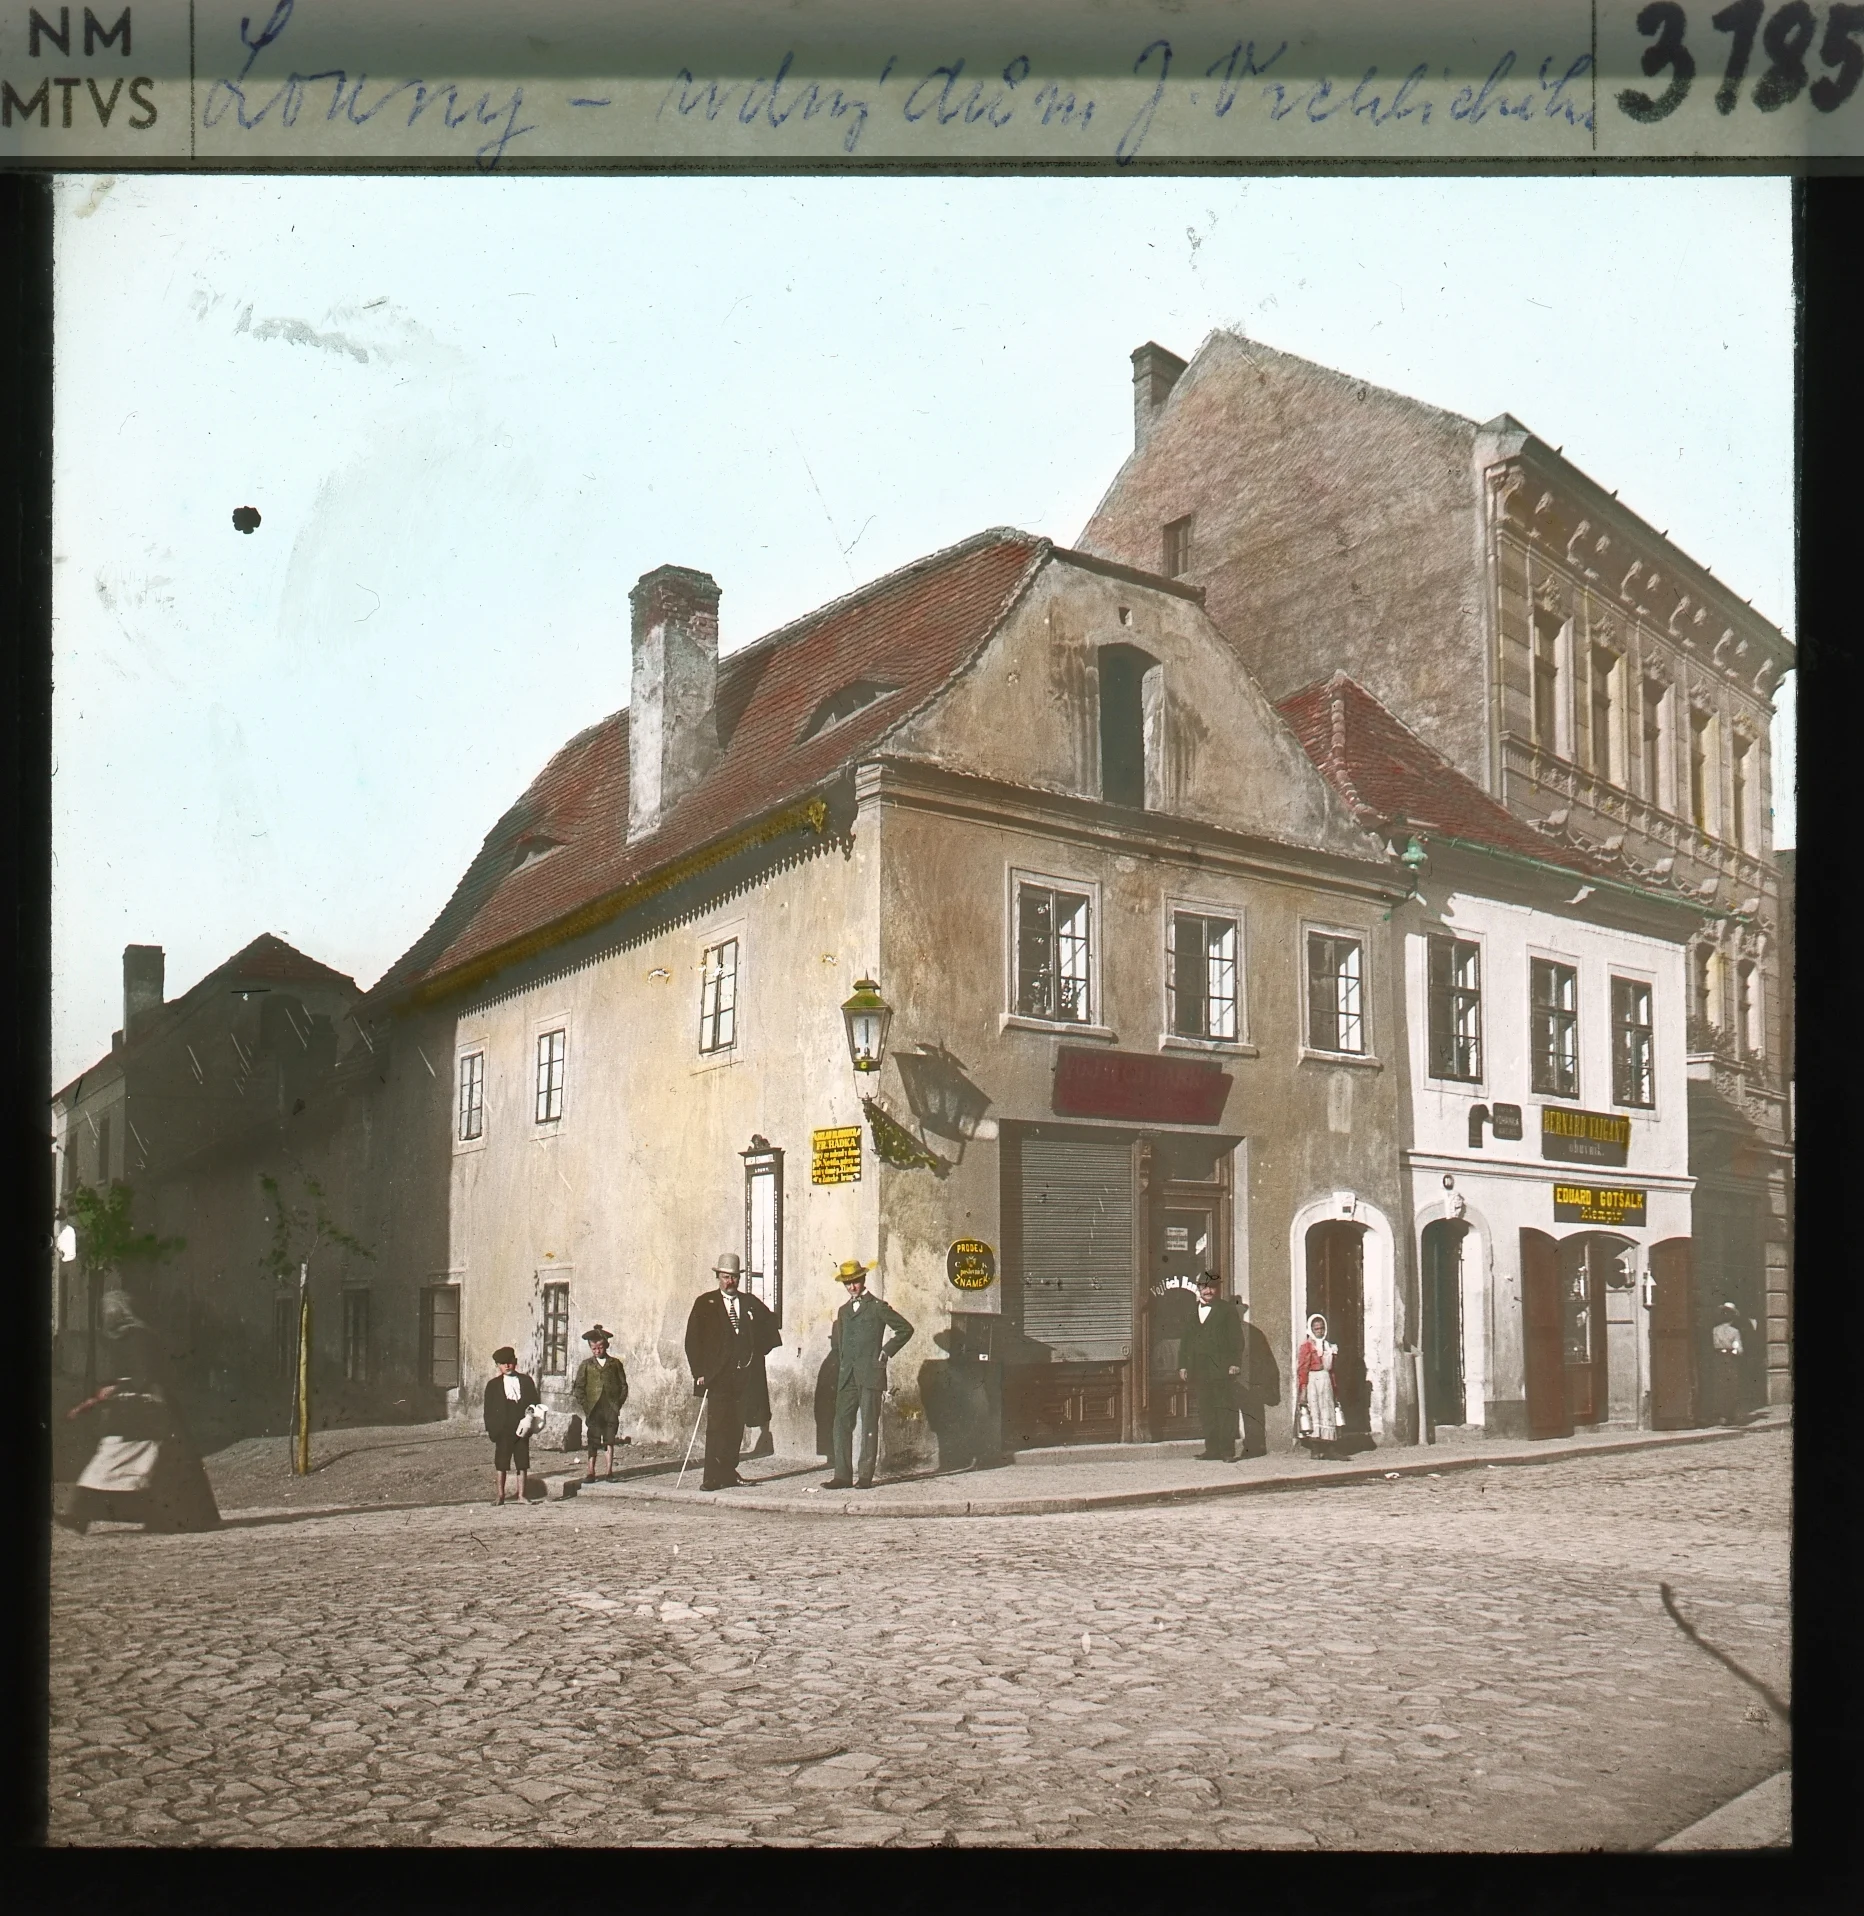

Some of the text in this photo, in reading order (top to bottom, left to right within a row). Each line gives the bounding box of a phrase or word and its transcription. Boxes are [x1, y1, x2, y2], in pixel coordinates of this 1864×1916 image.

[28, 6, 133, 57] NM
[0, 76, 159, 131] MTVS
[202, 0, 540, 169] Louny
[1556, 1187, 1592, 1206] EDUARD
[956, 1243, 984, 1254] PRODEJ
